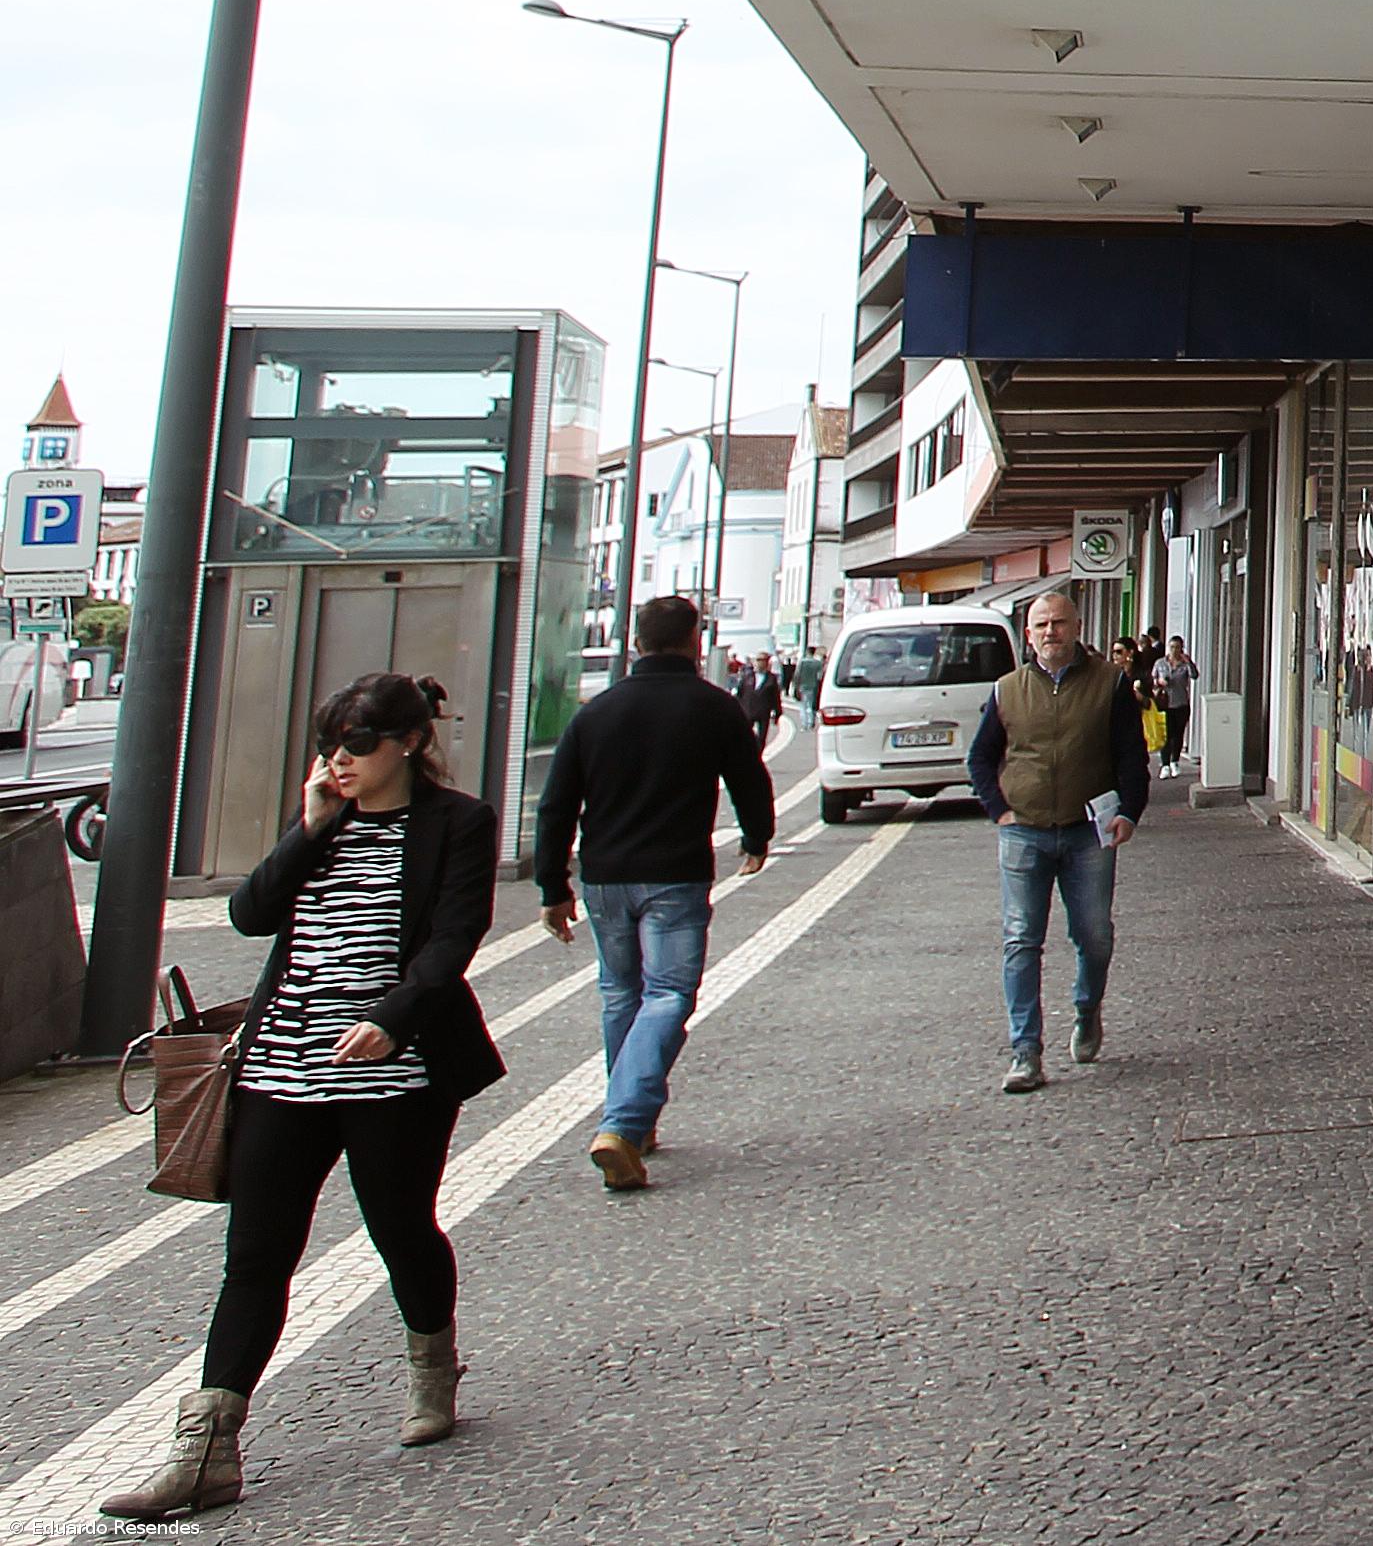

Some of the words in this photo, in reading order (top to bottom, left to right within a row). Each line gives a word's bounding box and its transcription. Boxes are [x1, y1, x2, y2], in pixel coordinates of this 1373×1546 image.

[37, 478, 73, 489] zona
[33, 498, 71, 542] P
[253, 597, 270, 617] P
